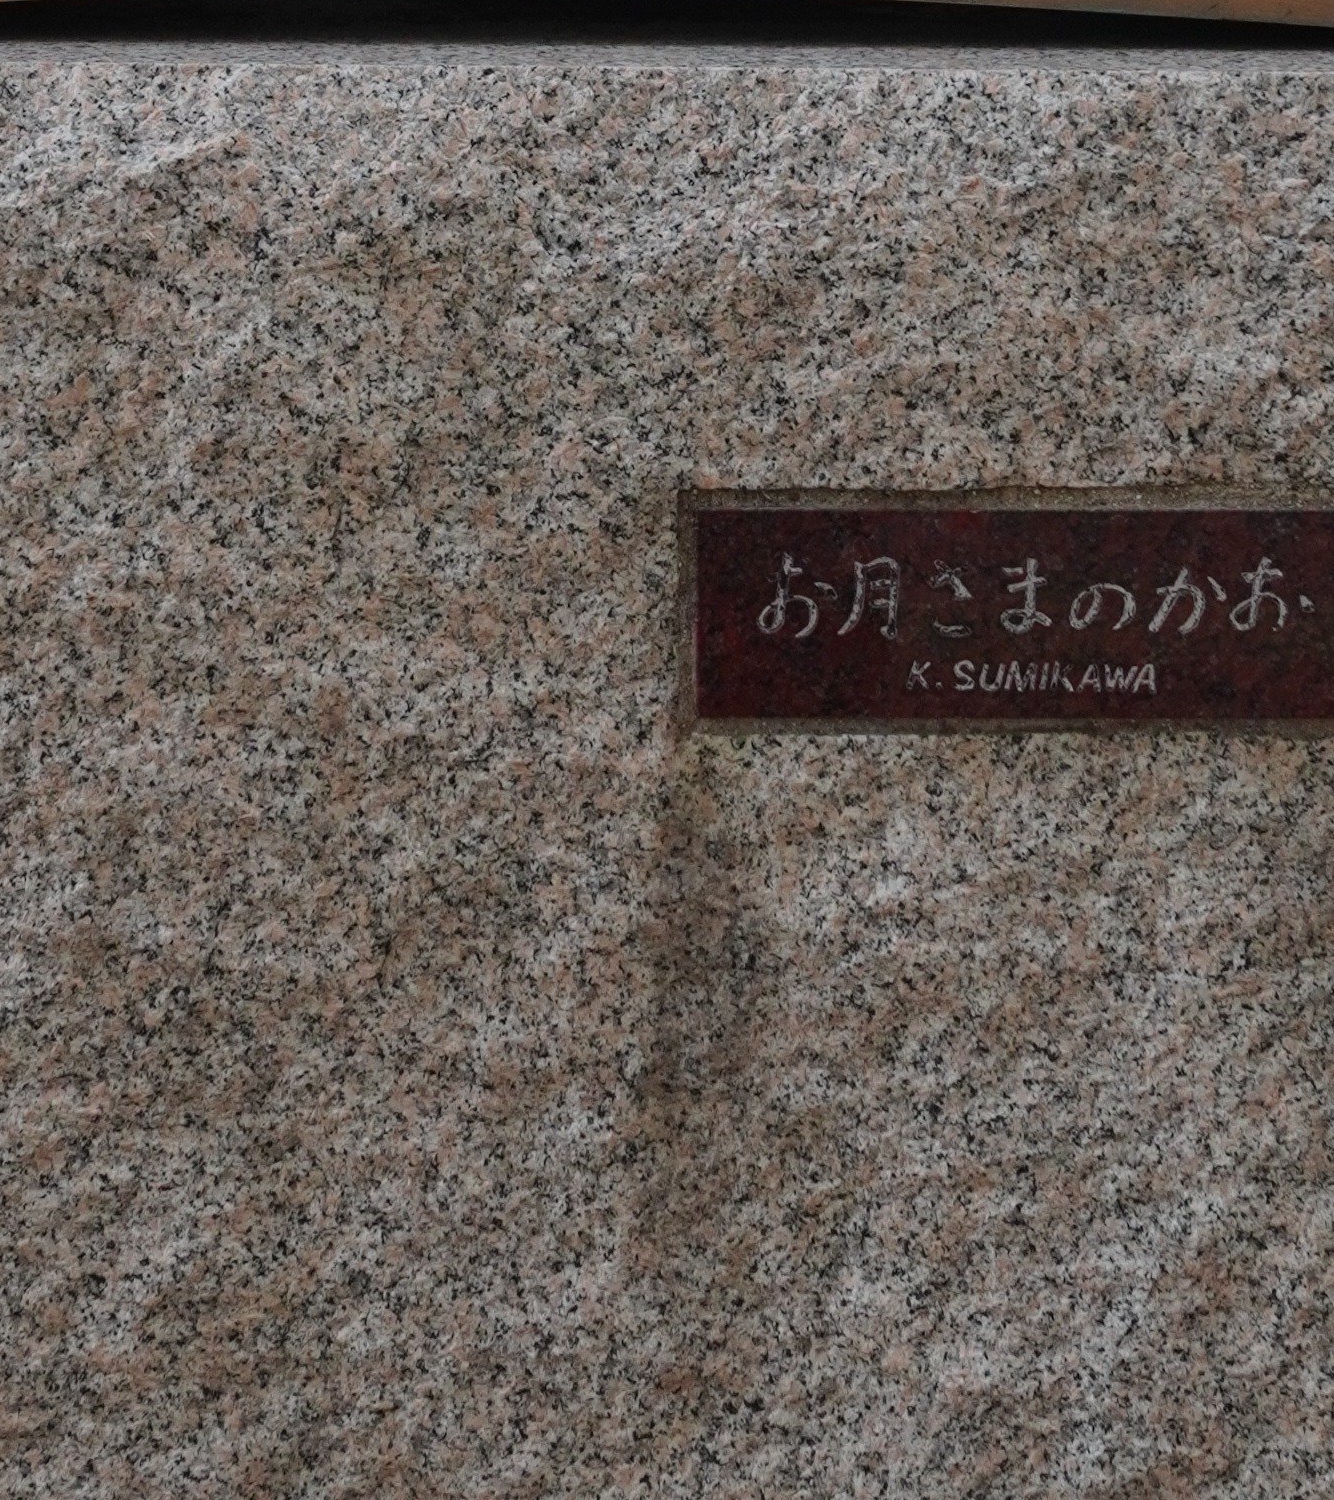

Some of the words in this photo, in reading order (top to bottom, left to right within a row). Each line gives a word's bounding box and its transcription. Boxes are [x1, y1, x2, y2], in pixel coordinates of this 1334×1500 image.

[757, 553, 1315, 637] お月さまのかお
[953, 659, 1157, 694] SUMIKAWA
